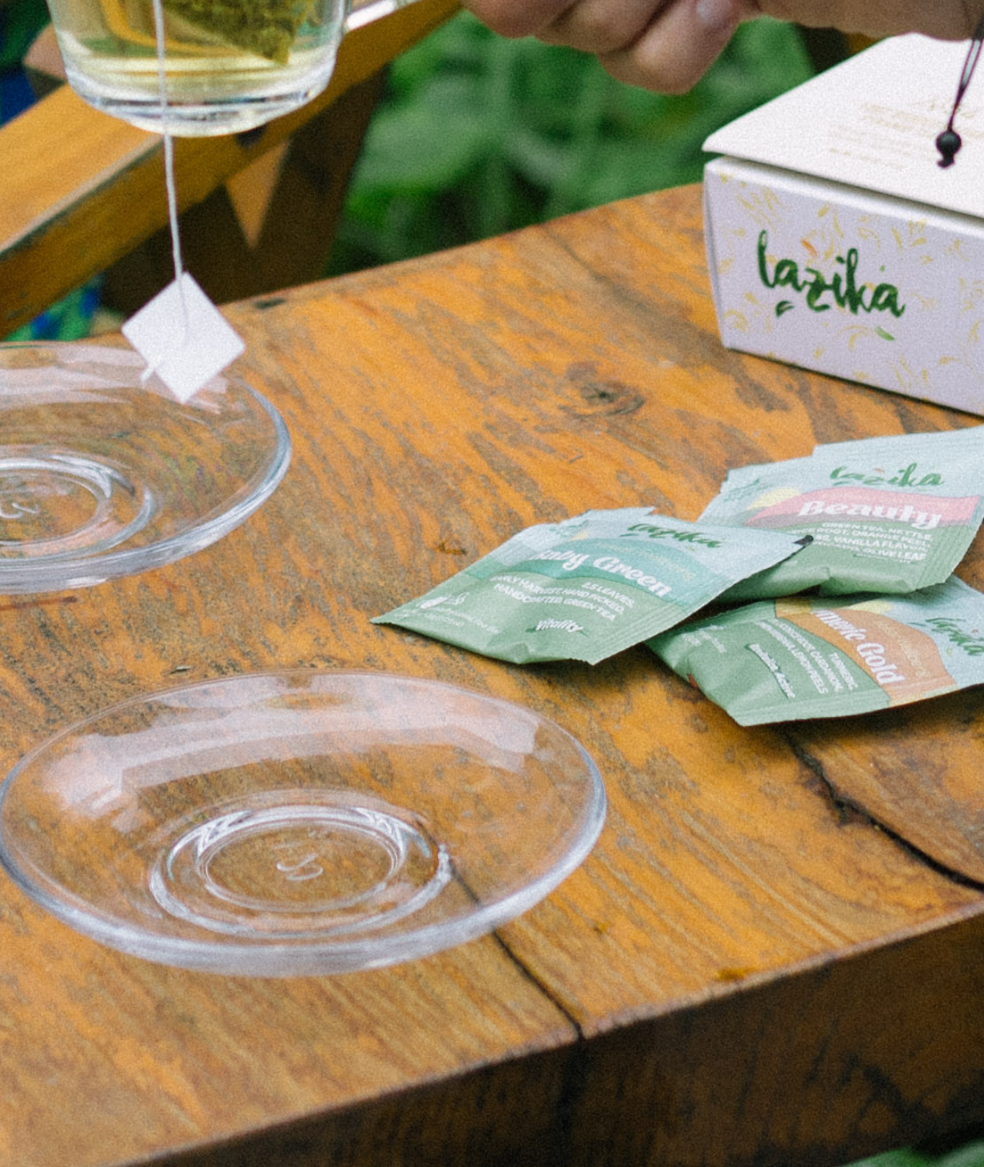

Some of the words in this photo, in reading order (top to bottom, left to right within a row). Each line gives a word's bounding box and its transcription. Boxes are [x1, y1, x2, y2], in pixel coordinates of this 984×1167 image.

[757, 230, 905, 318] lazika
[797, 500, 943, 530] Beauty
[593, 556, 672, 597] Green
[857, 642, 906, 684] Gold
